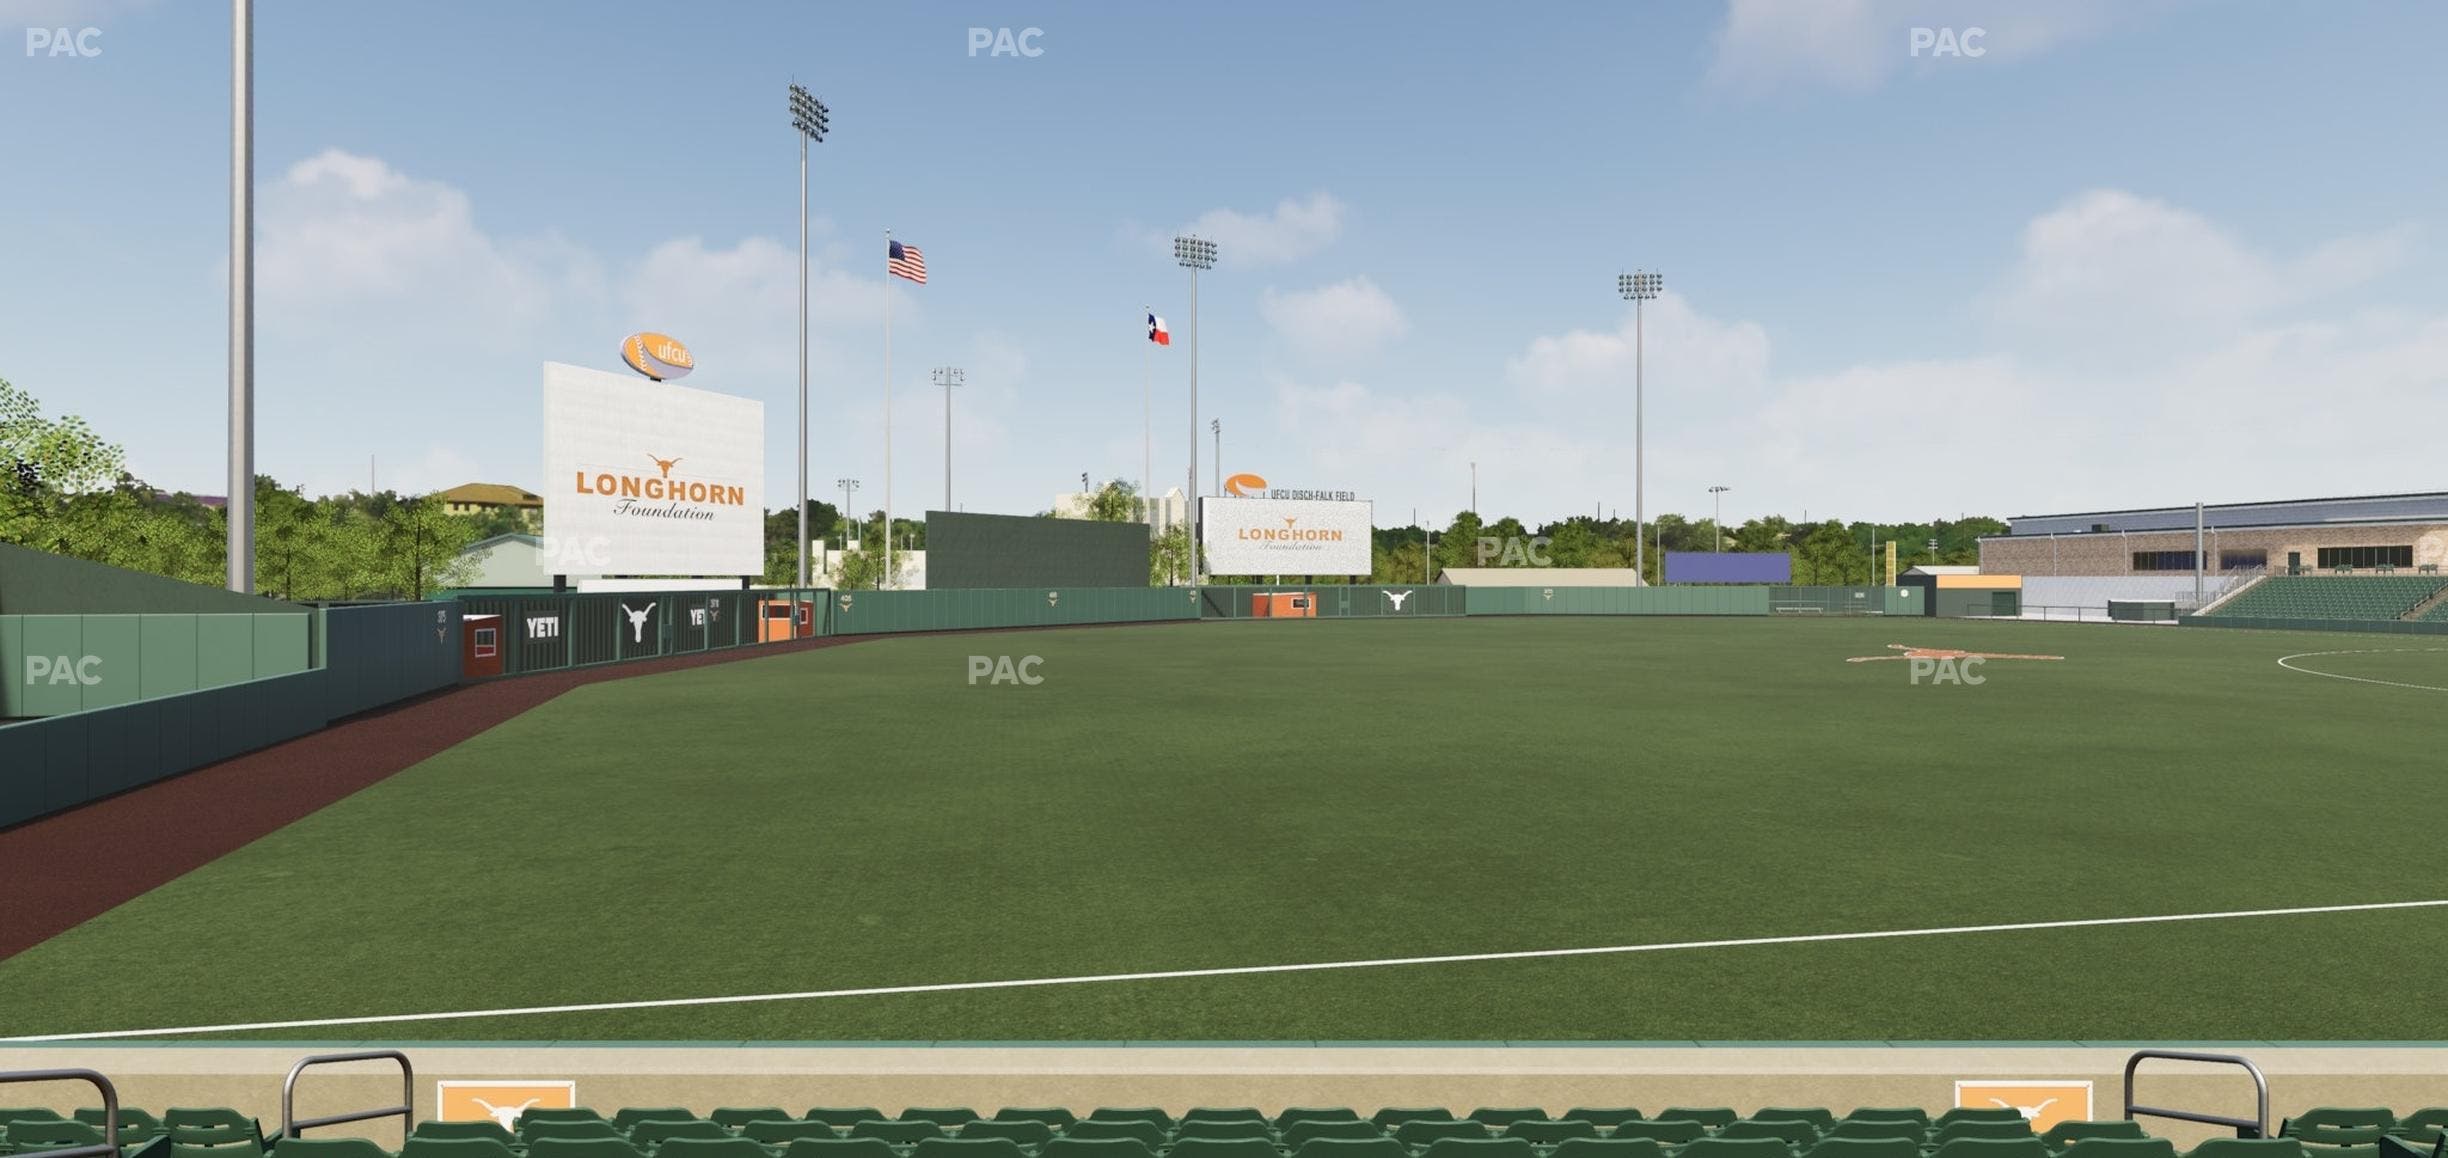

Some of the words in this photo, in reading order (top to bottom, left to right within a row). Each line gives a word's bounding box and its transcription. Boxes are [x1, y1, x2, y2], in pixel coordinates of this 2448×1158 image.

[658, 341, 686, 363] ufcu
[576, 471, 744, 506] LONGHORN
[1271, 489, 1290, 500] UFCU
[1292, 490, 1333, 501] DISCH-FALK
[1335, 491, 1355, 502] FIELD
[613, 498, 715, 522] Foundation
[1238, 528, 1343, 541] LONGHORN
[526, 616, 559, 639] YETI
